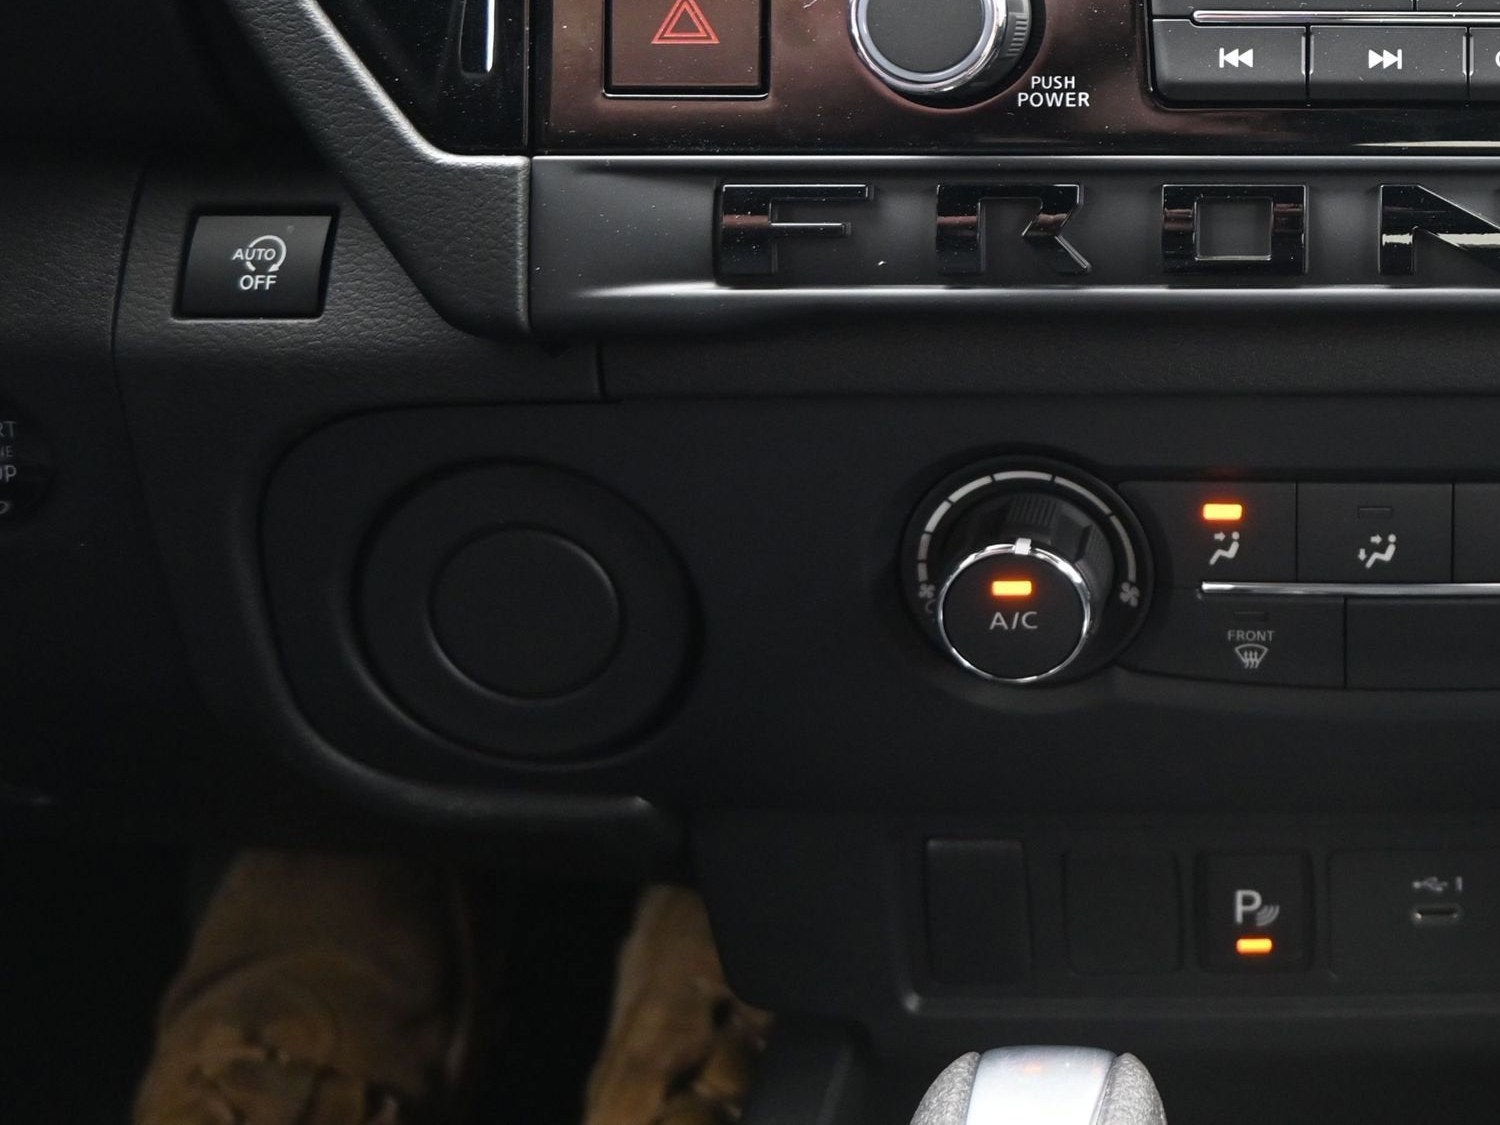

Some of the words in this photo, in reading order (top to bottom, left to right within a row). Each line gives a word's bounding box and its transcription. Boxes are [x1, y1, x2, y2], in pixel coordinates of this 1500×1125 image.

[1031, 75, 1076, 90] PUSH
[1017, 91, 1090, 108] POWER
[231, 248, 277, 261] AUTO
[239, 274, 277, 291] OFF
[989, 611, 1038, 630] A/C
[1227, 629, 1274, 642] FRONT
